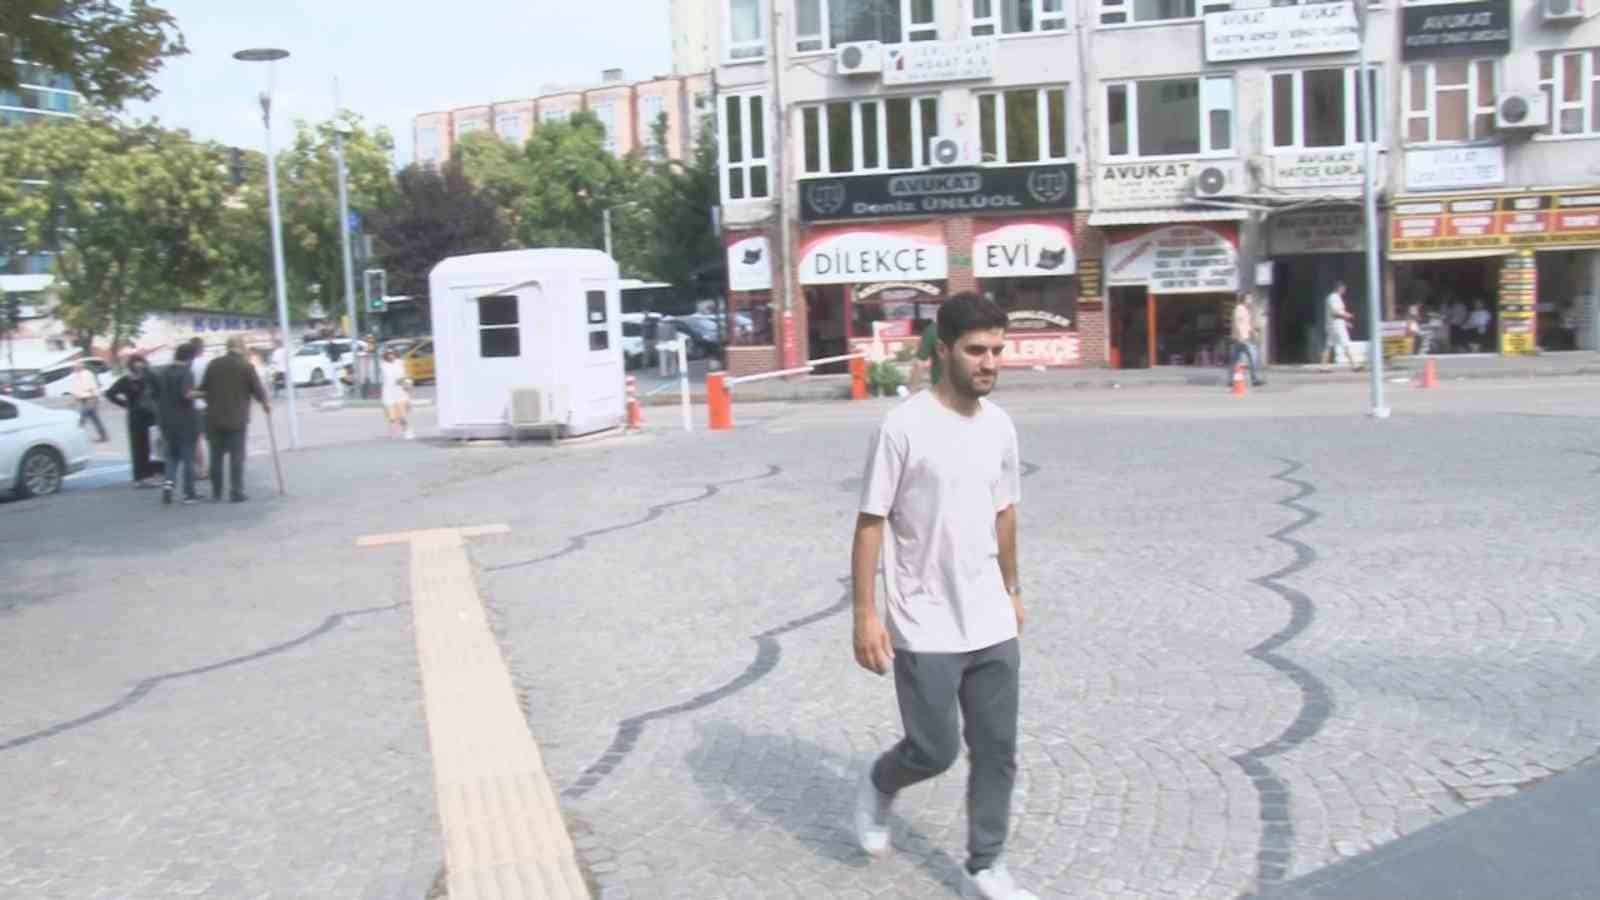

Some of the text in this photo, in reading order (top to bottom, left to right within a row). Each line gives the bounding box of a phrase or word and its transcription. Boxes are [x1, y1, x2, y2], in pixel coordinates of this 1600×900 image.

[1422, 12, 1494, 29] AVUKAT
[1103, 163, 1192, 182] AVUKAT
[892, 174, 979, 195] AVUKAT
[852, 202, 918, 215] Deniz
[814, 247, 928, 276] DİLEKÇE
[986, 239, 1031, 269] EVİ
